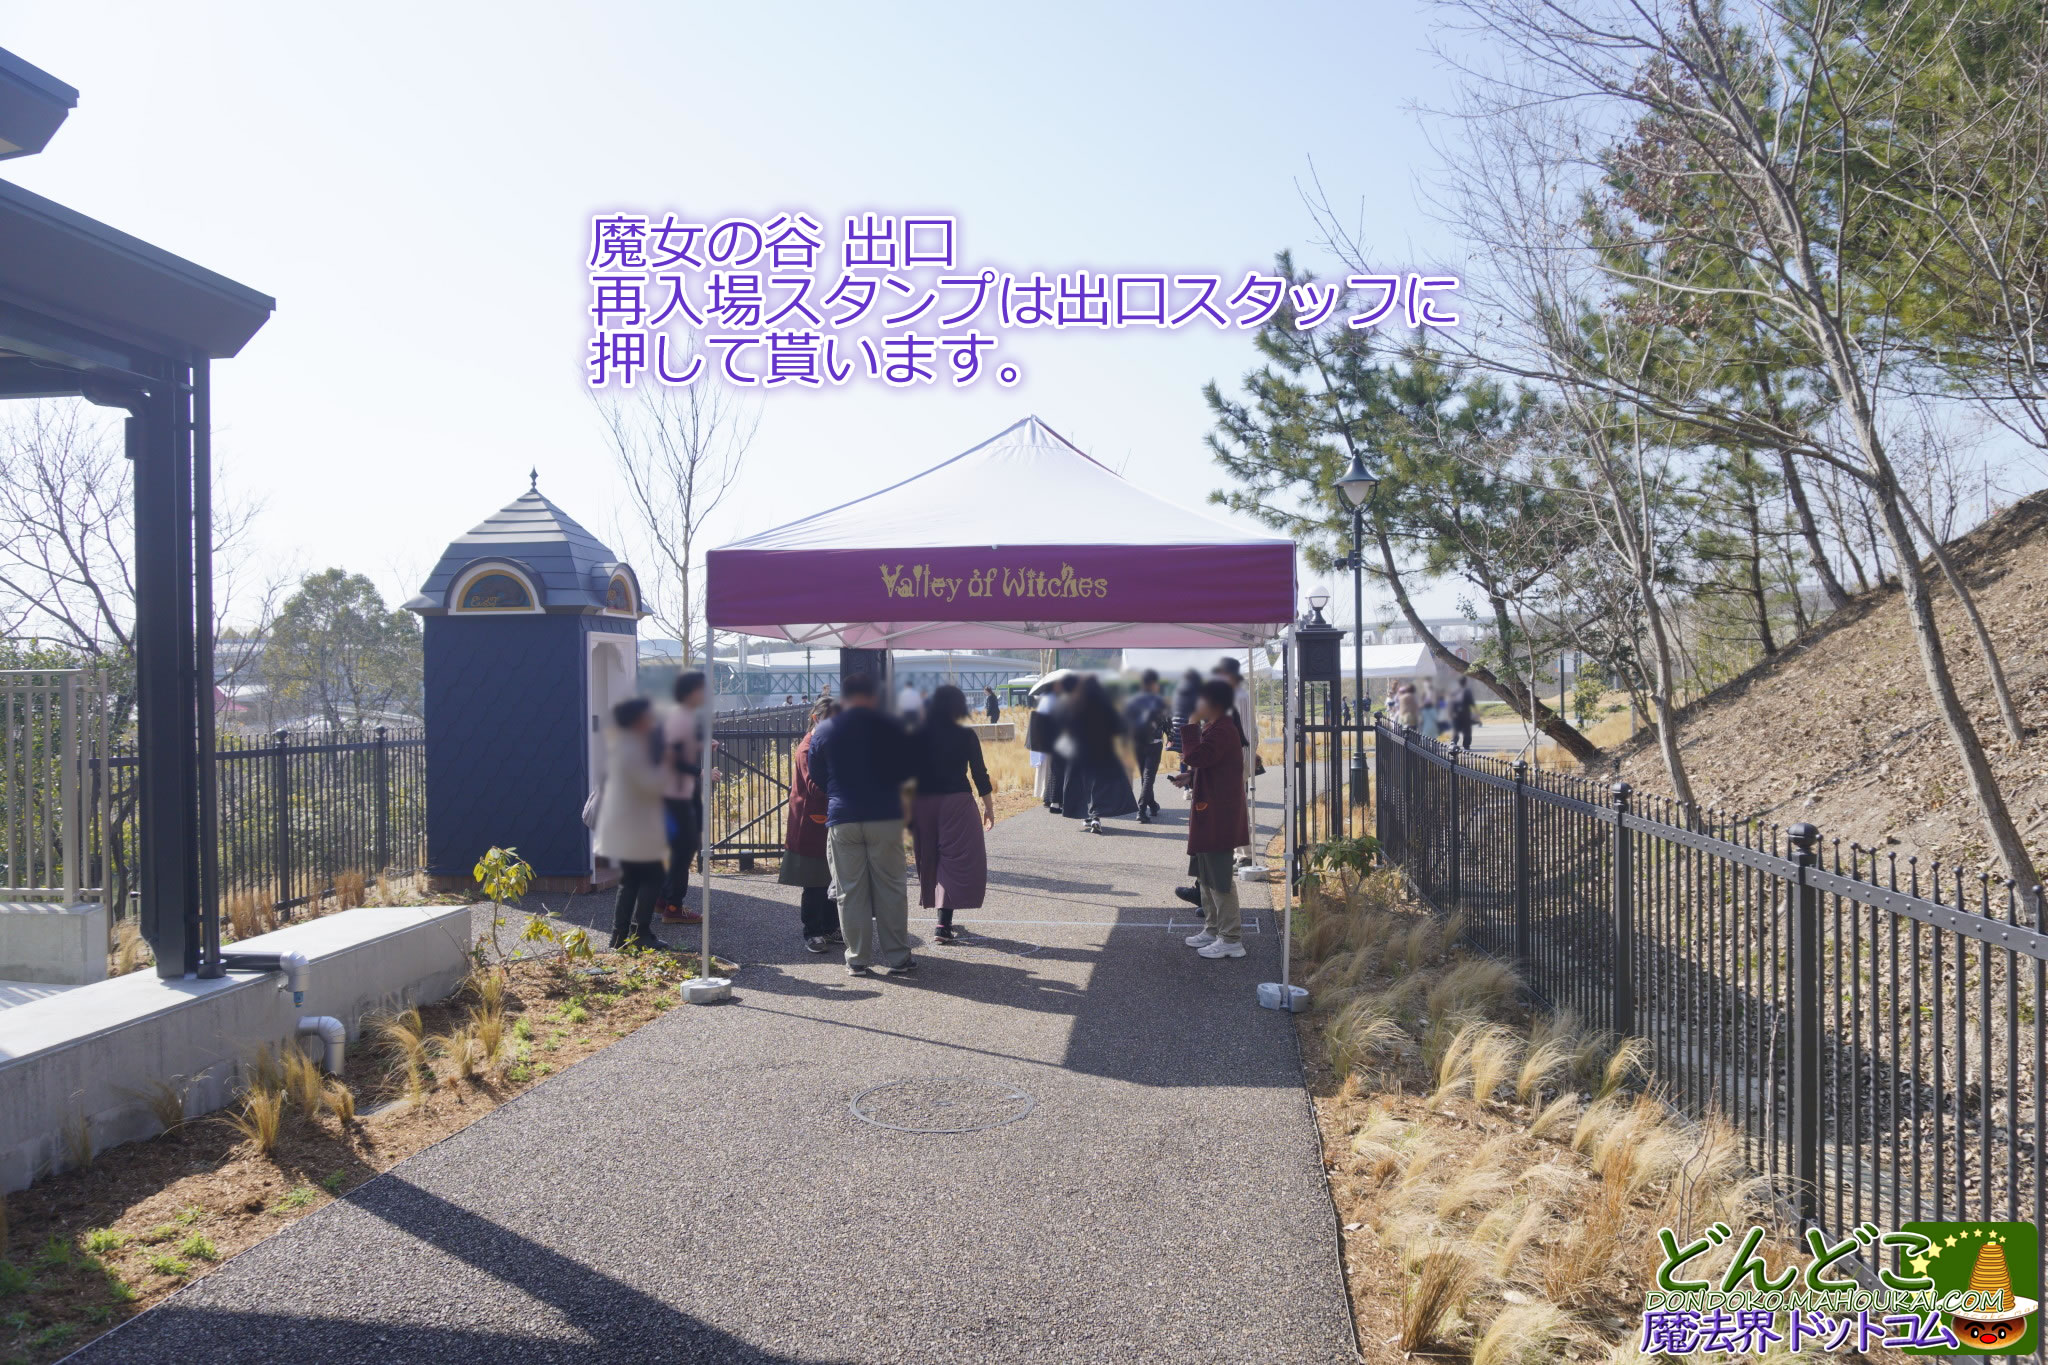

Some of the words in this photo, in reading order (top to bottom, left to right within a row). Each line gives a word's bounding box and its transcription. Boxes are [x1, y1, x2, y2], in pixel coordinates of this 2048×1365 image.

[880, 563, 963, 602] Valley
[968, 568, 998, 598] of
[1002, 561, 1108, 599] Witches
